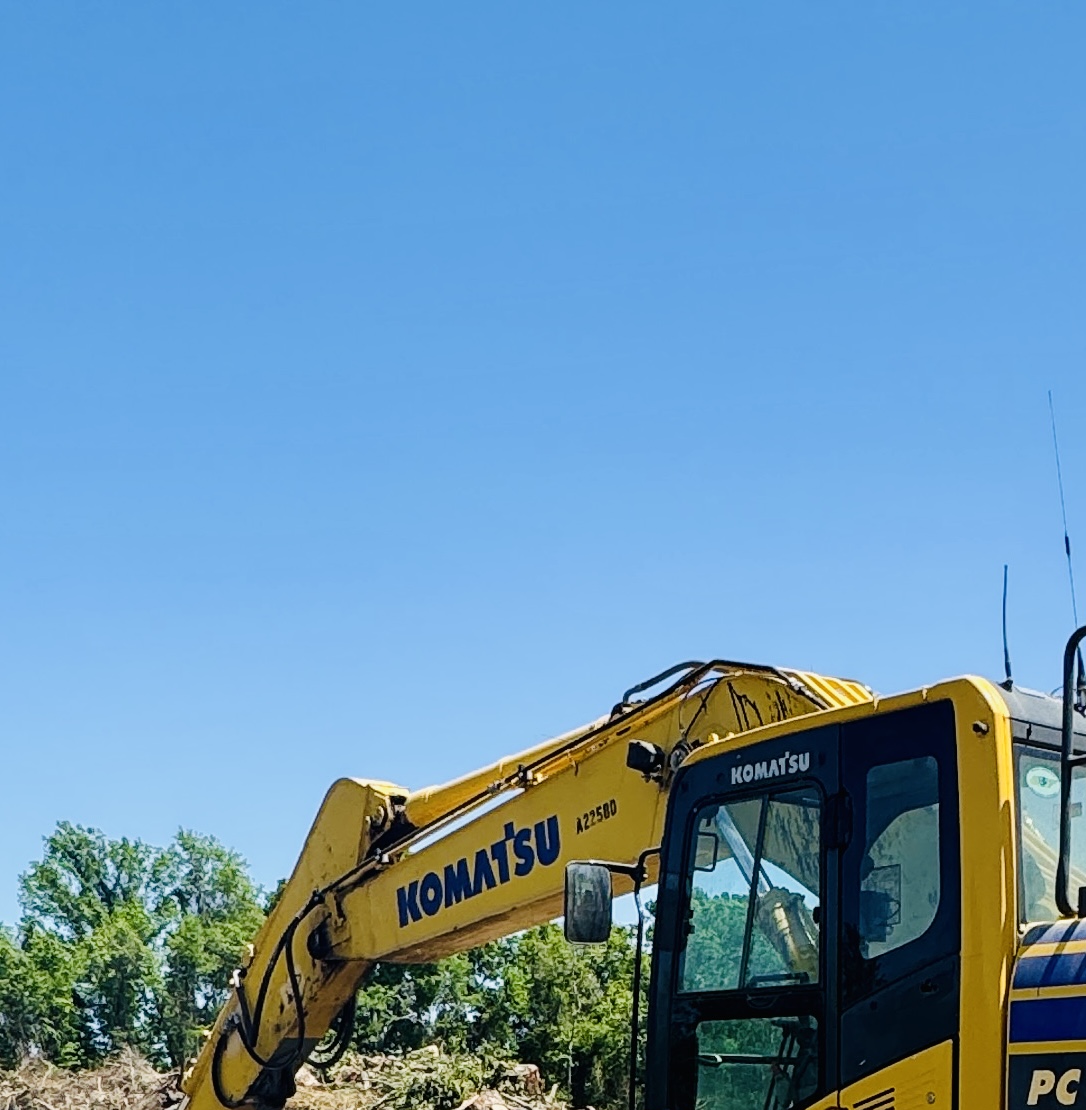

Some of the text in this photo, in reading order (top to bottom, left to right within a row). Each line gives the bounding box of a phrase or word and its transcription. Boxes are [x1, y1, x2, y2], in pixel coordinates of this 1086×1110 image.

[731, 751, 810, 785] KOMATSU
[397, 815, 561, 928] KOMATSU
[1027, 1068, 1082, 1106] PC
